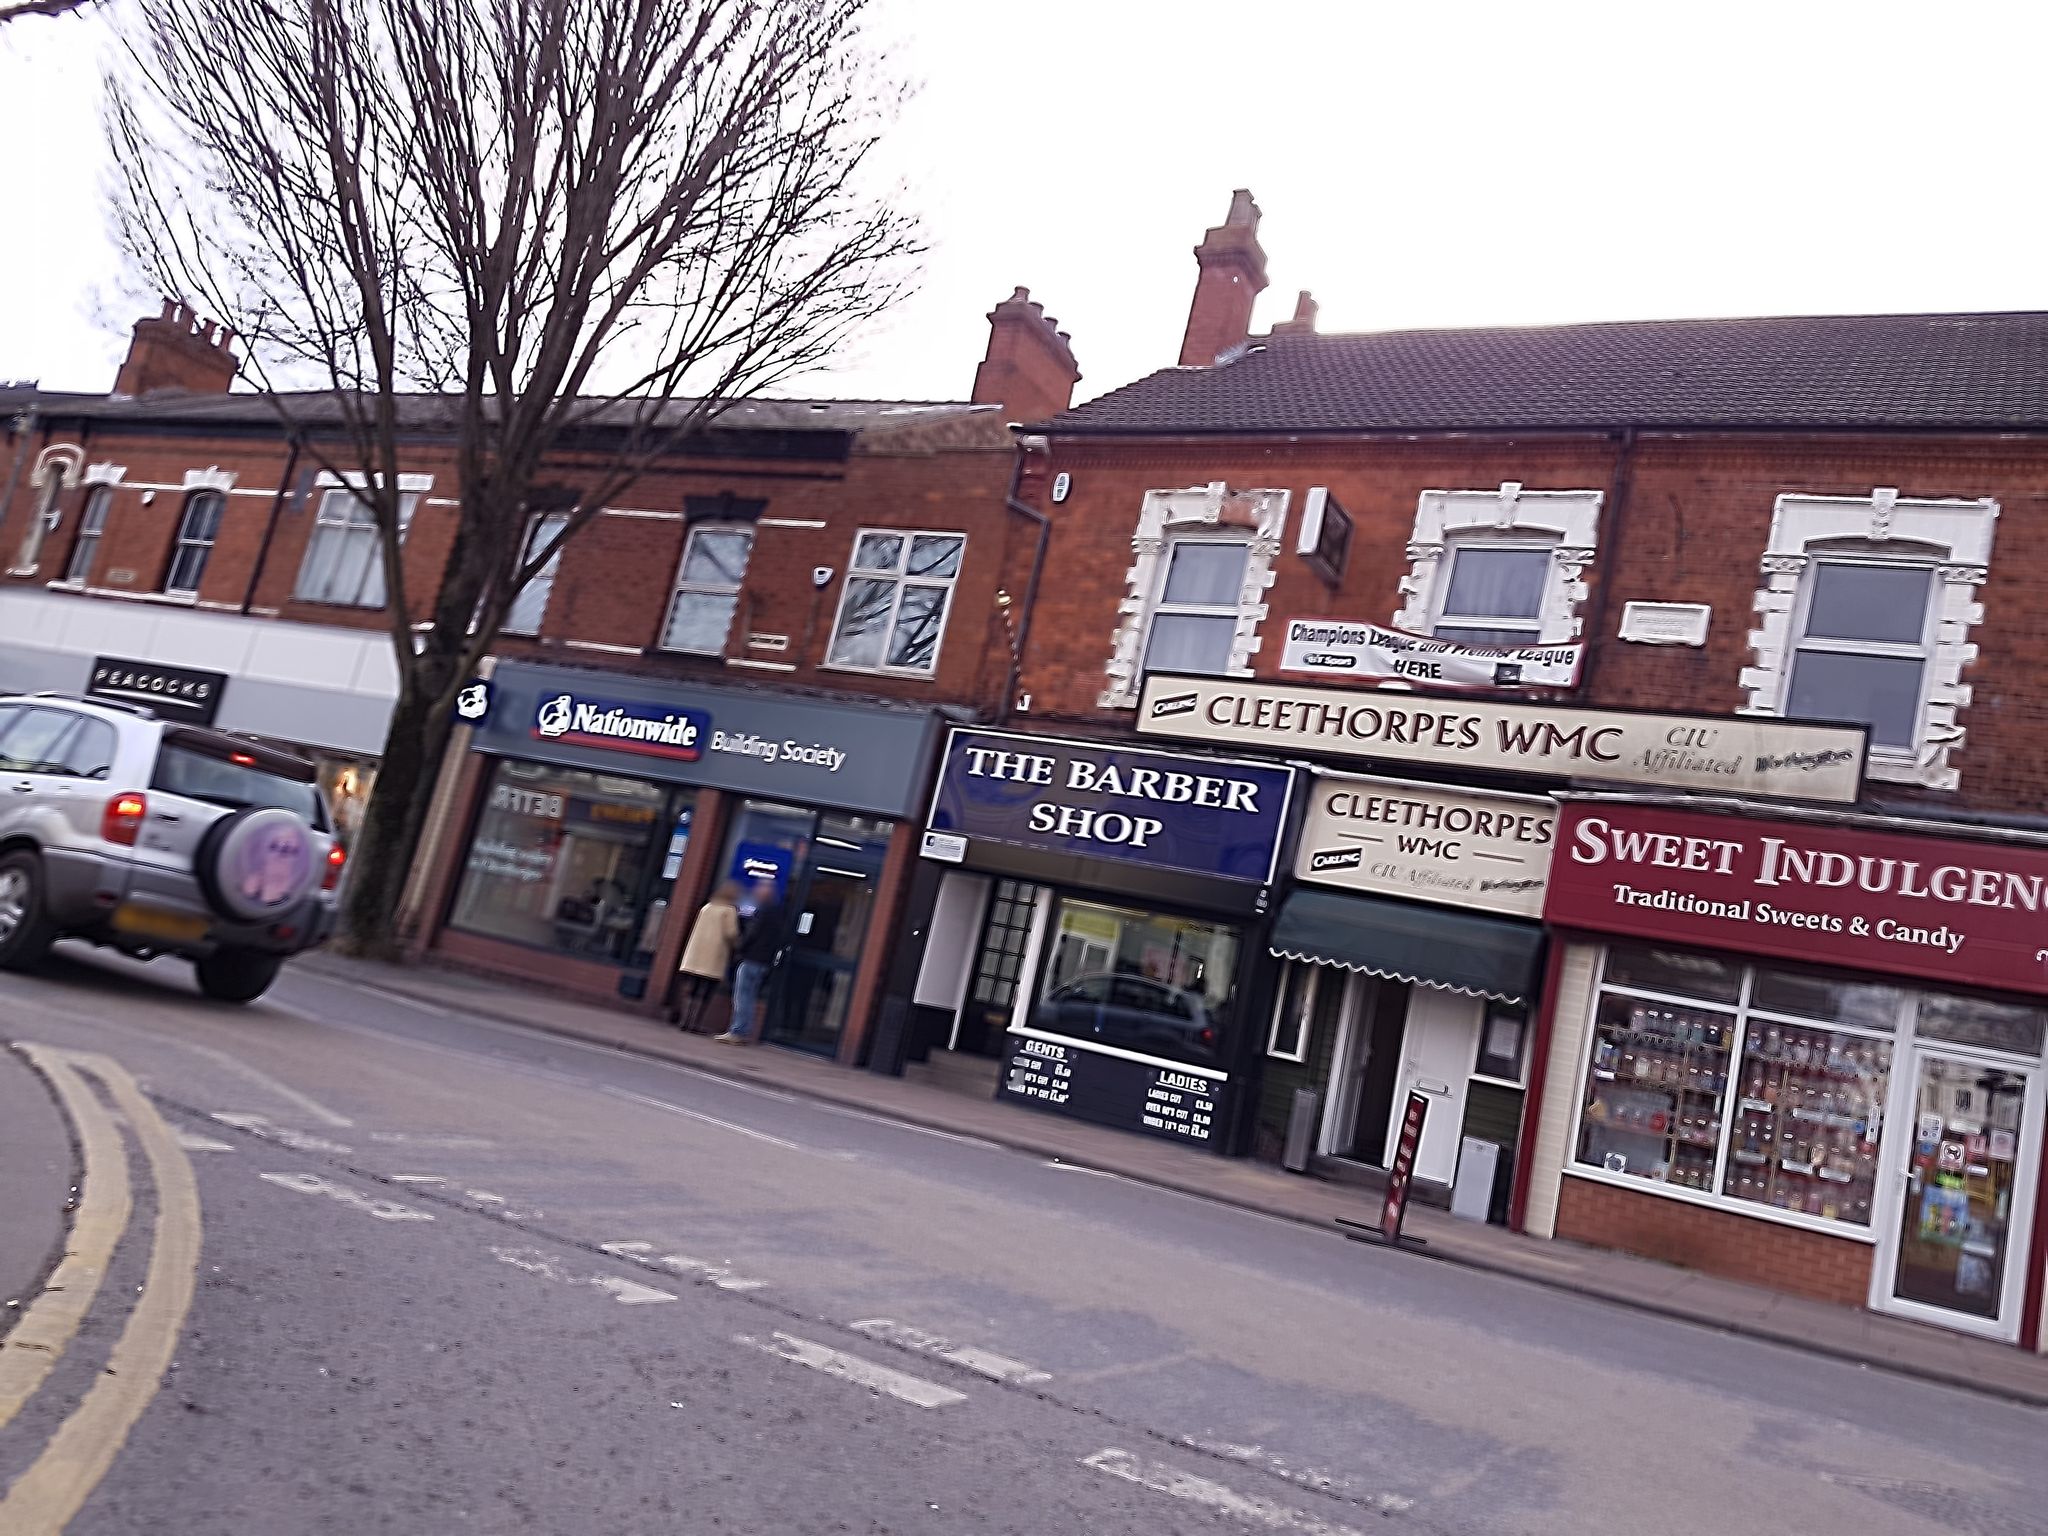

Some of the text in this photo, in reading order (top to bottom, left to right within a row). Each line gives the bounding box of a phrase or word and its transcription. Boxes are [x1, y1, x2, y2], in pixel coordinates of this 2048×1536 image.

[1291, 623, 1366, 647] Champions
[1370, 628, 1415, 653] League
[1419, 643, 1451, 653] and
[1517, 647, 1575, 667] League
[95, 668, 210, 698] PEACOCKS
[1394, 659, 1442, 679] HERE
[571, 703, 697, 746] Nationwide
[1207, 695, 1623, 763] CLEETHORPES WMC
[711, 731, 846, 772] Building Society
[1633, 749, 1742, 775] Affiliated
[966, 747, 1259, 813] THE BARBER
[1029, 803, 1163, 847] SHOP
[1327, 793, 1553, 844] CLEETHORPES
[1398, 835, 1461, 860] WMC
[1572, 818, 2048, 911] SWEET INDULGEN
[1613, 884, 1964, 954] Traditional Sweets & Candy
[1026, 1040, 1065, 1058] GENTS
[1160, 1071, 1208, 1092] LADIES
